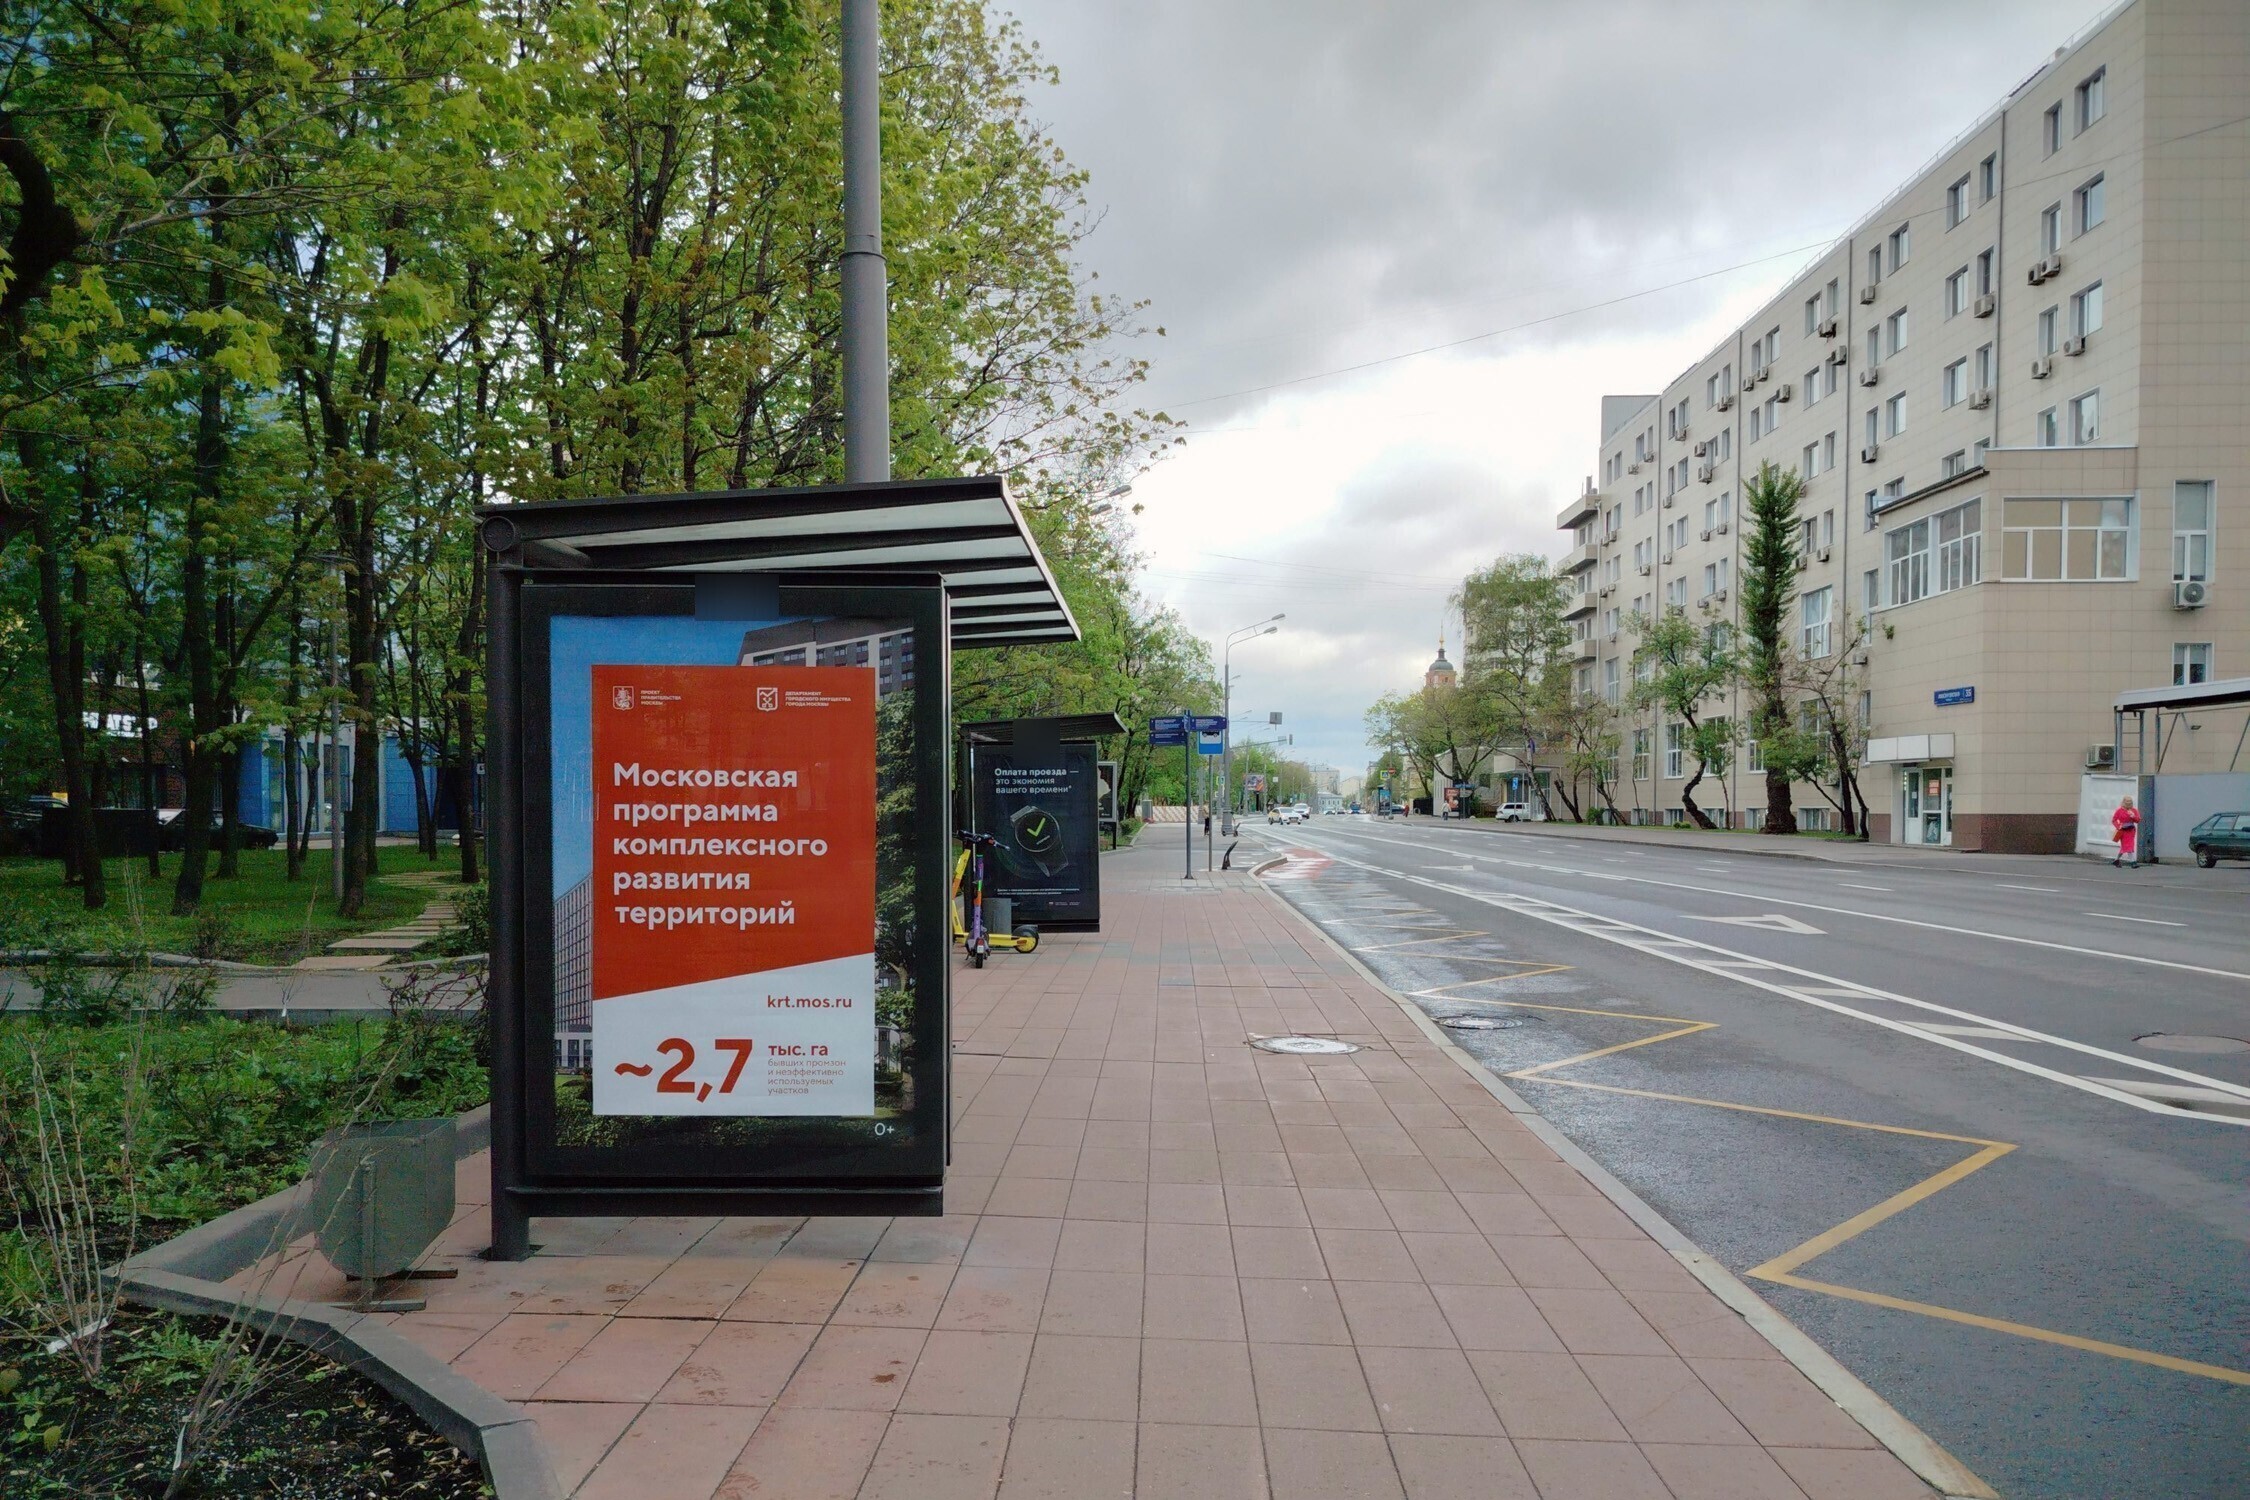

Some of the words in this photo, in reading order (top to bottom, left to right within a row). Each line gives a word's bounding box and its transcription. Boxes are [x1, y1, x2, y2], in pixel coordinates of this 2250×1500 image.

[614, 763, 798, 787] Московская
[994, 768, 1027, 776] Оплата
[1029, 769, 1067, 777] проезда
[613, 803, 778, 828] программа
[613, 837, 828, 857] комплексного
[613, 872, 750, 896] развития
[615, 900, 796, 931] территорий
[767, 995, 852, 1009] krt.mos.ru
[768, 1045, 806, 1056] тыс.
[811, 1045, 829, 1056] га
[767, 1059, 804, 1067] бывших
[806, 1060, 847, 1068] промзон
[776, 1068, 844, 1077] неэффективно
[767, 1079, 834, 1087] используемых
[767, 1087, 809, 1096] участков
